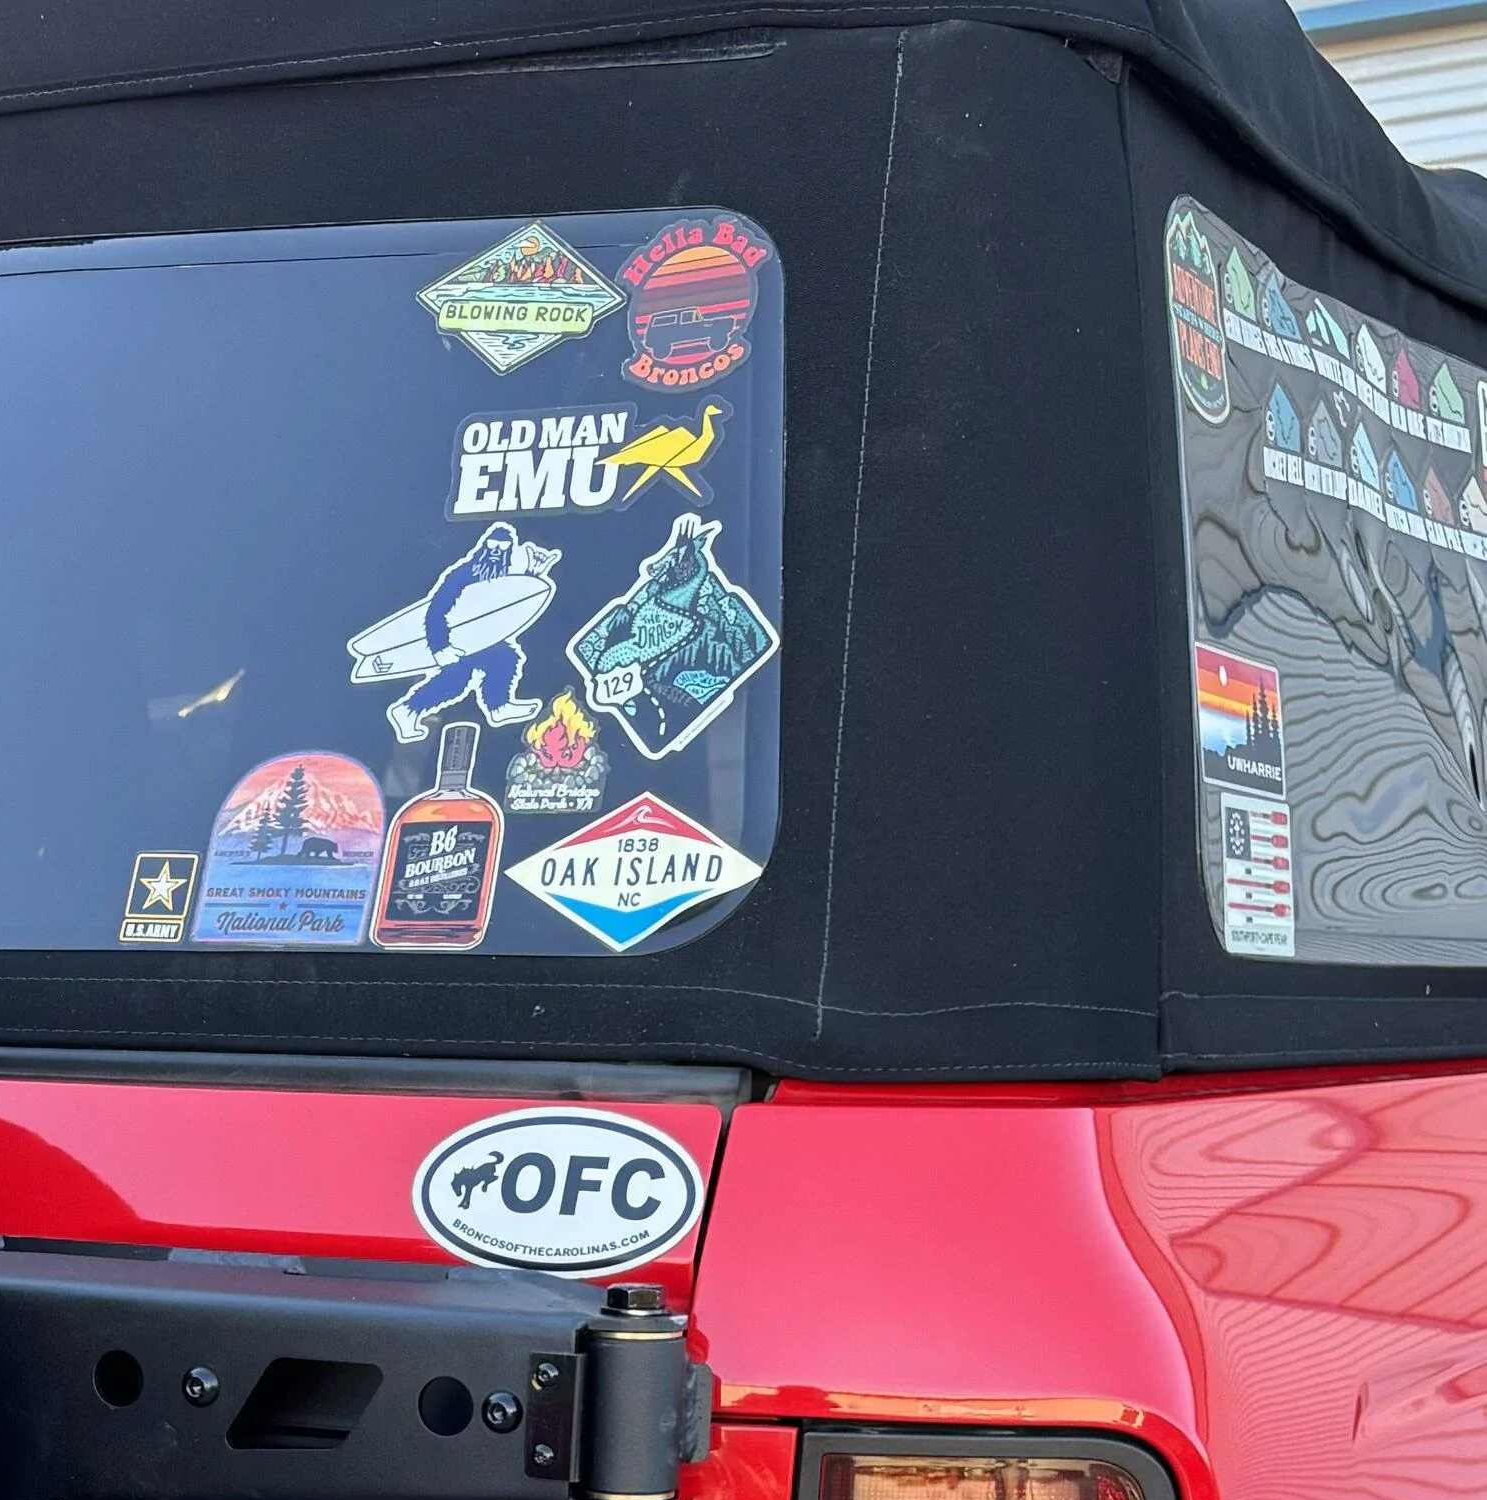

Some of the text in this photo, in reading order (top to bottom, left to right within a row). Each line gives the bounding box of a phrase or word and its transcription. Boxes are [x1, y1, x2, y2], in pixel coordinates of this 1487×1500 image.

[622, 222, 768, 286] Hella Bad
[445, 304, 589, 323] BLOWING ROCK
[628, 343, 745, 386] Broncos
[462, 412, 629, 453] OLD MAN
[453, 445, 626, 514] EMU
[634, 619, 684, 649] DRAGON
[603, 673, 634, 698] 129
[1227, 754, 1282, 782] UWHARRIE
[429, 825, 458, 856] B6
[617, 838, 659, 853] 1838
[404, 847, 477, 879] BOURBON
[541, 853, 724, 886] OAK ISLAND
[206, 887, 366, 900] GREAT SMOKY MOUNTAINS
[617, 892, 641, 908] NC
[217, 911, 345, 935] National Park
[500, 1152, 666, 1221] OFC
[452, 1218, 651, 1258] BRONCOSOFTHECAROLINAS.COM
